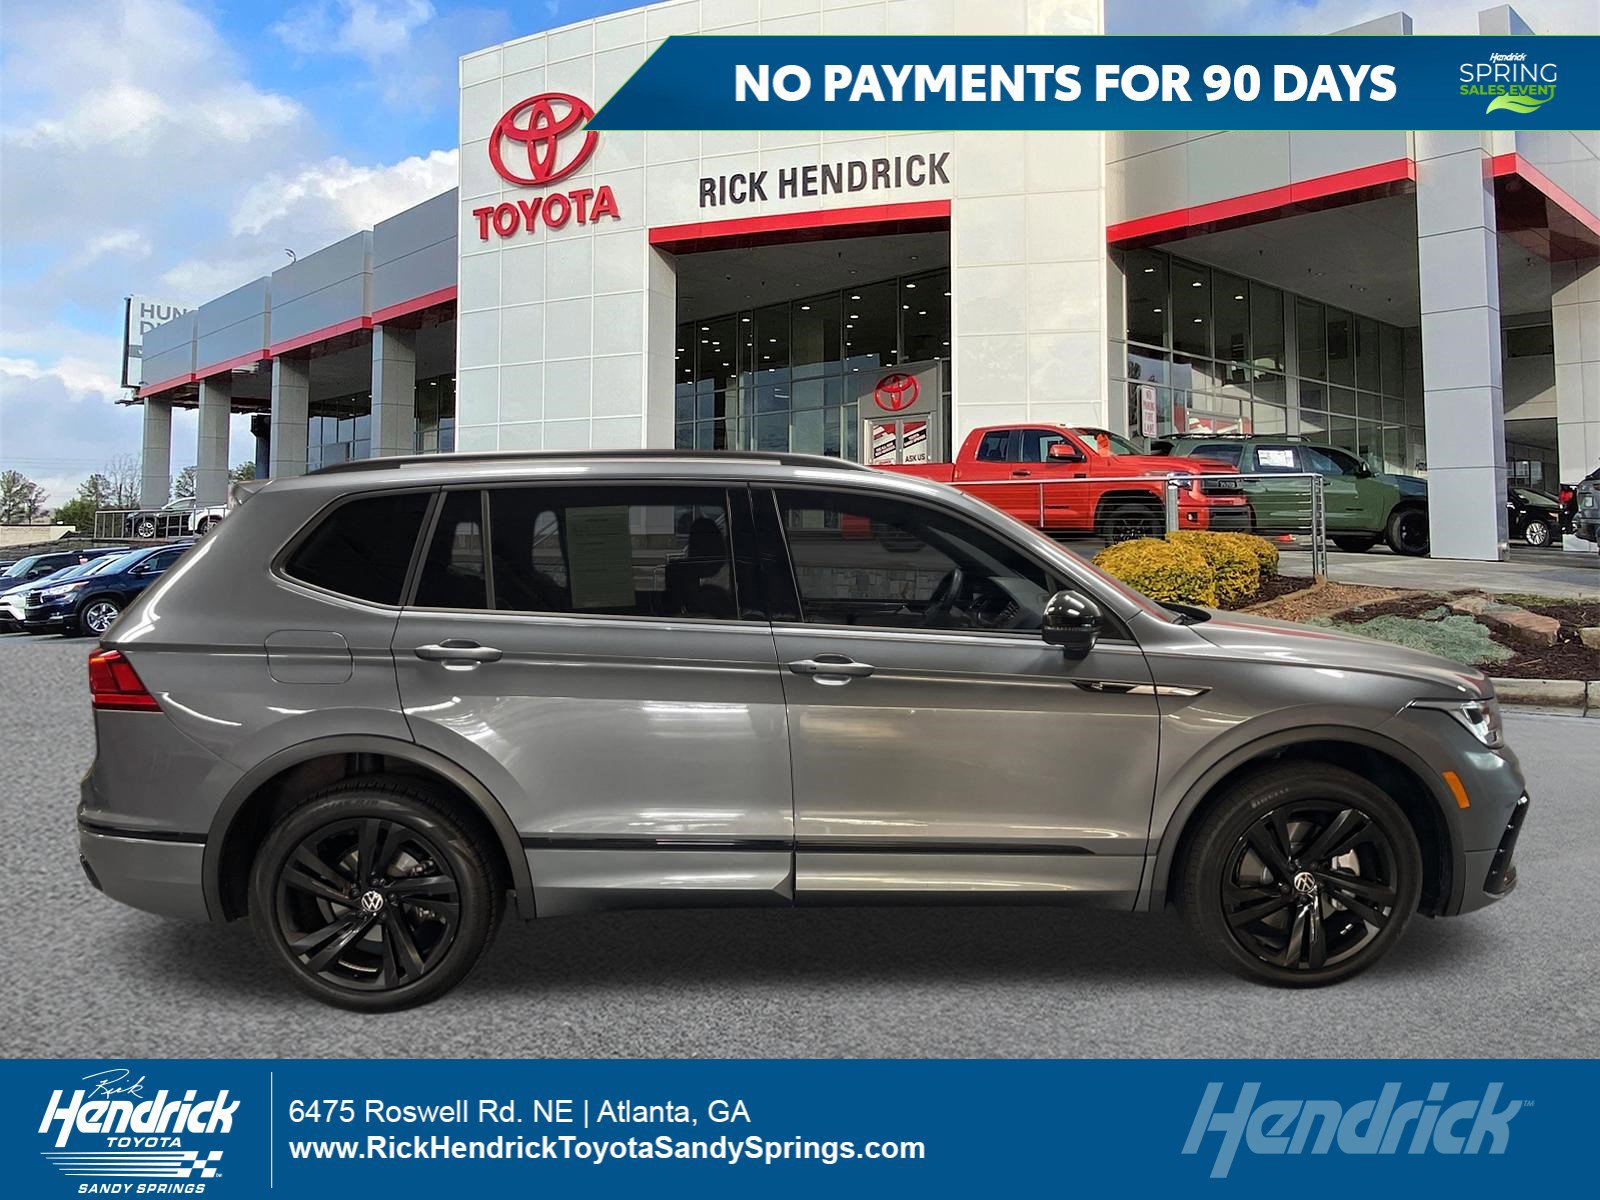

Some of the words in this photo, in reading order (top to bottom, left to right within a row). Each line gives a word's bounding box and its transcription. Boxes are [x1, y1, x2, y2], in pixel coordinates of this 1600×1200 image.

[699, 170, 768, 208] RICK
[778, 152, 951, 199] HENDRICK
[472, 185, 620, 240] TOYOTA
[904, 454, 917, 463] ASK
[917, 453, 926, 461] US
